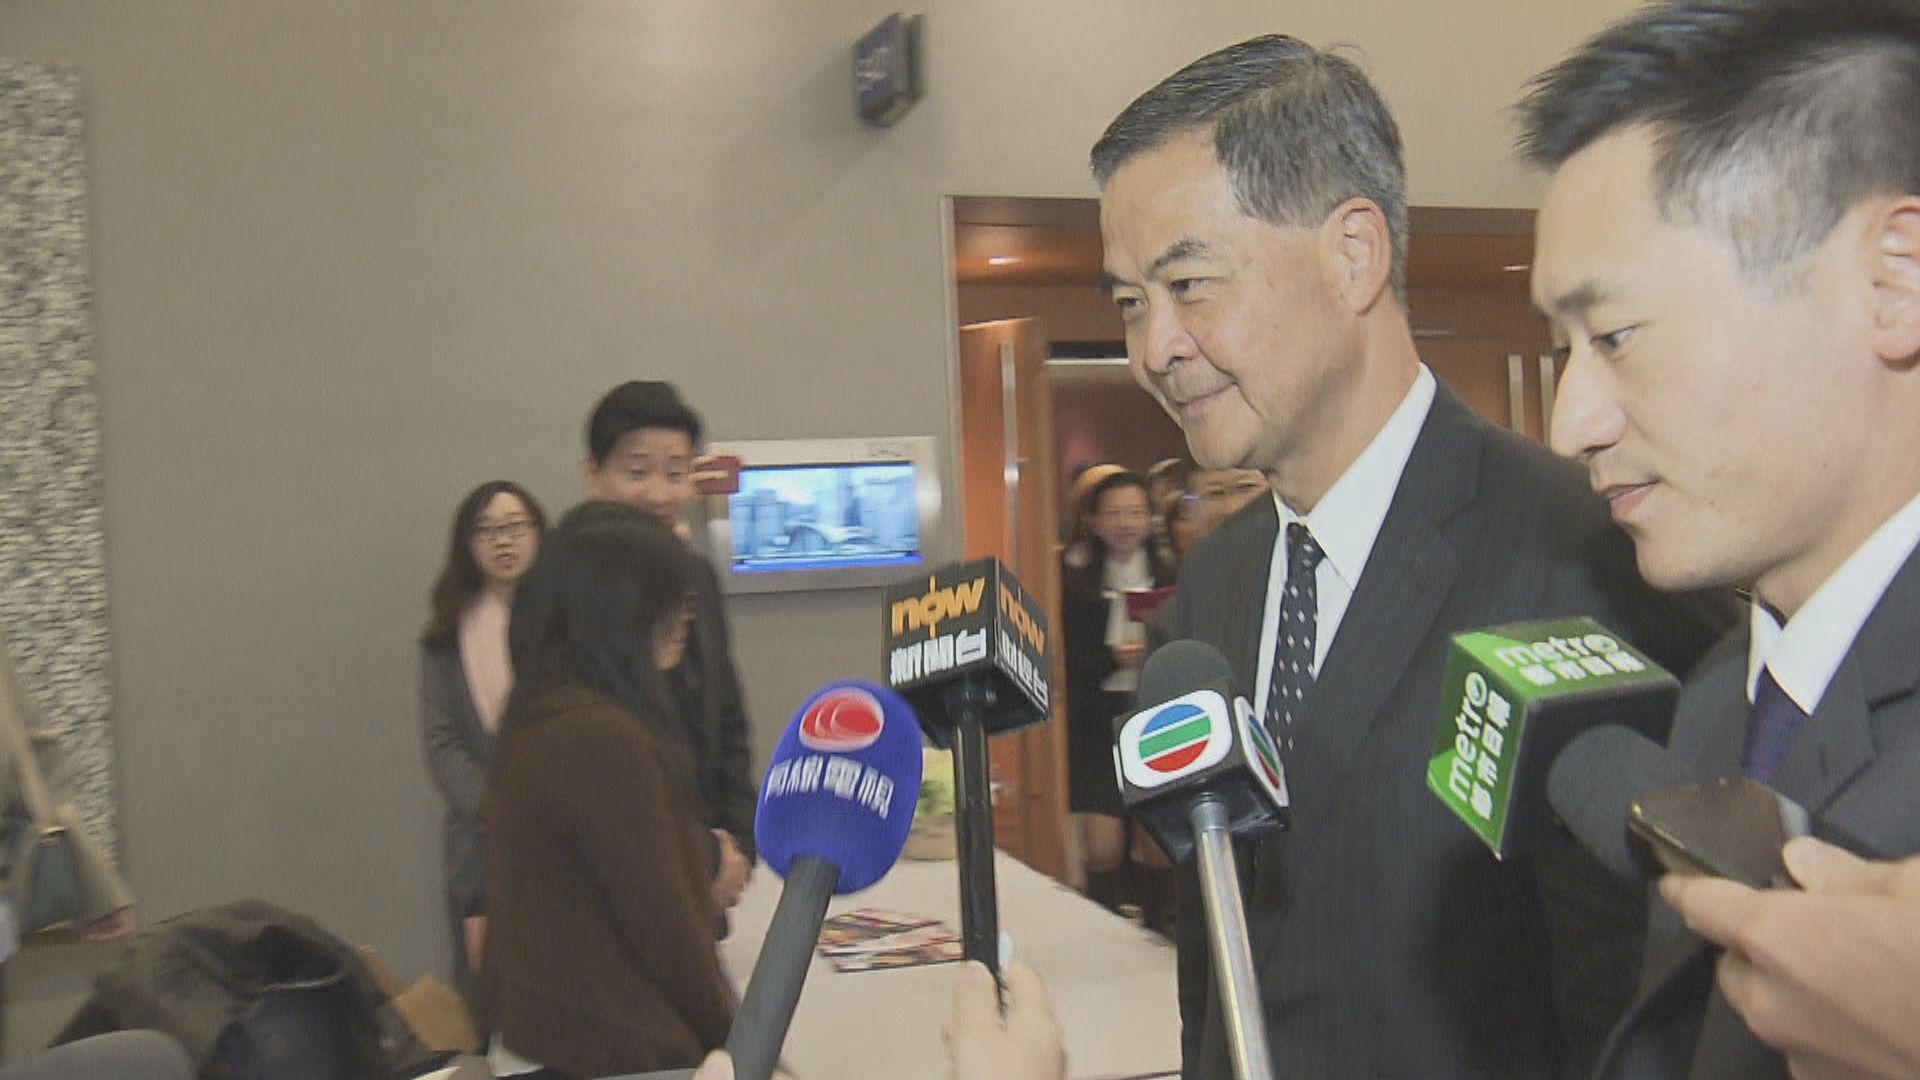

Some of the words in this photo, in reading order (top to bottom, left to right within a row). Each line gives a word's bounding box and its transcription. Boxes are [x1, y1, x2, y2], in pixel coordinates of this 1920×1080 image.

[892, 575, 986, 639] now
[1001, 586, 1045, 656] now
[1494, 634, 1619, 667] metro
[1450, 671, 1488, 803] metro
